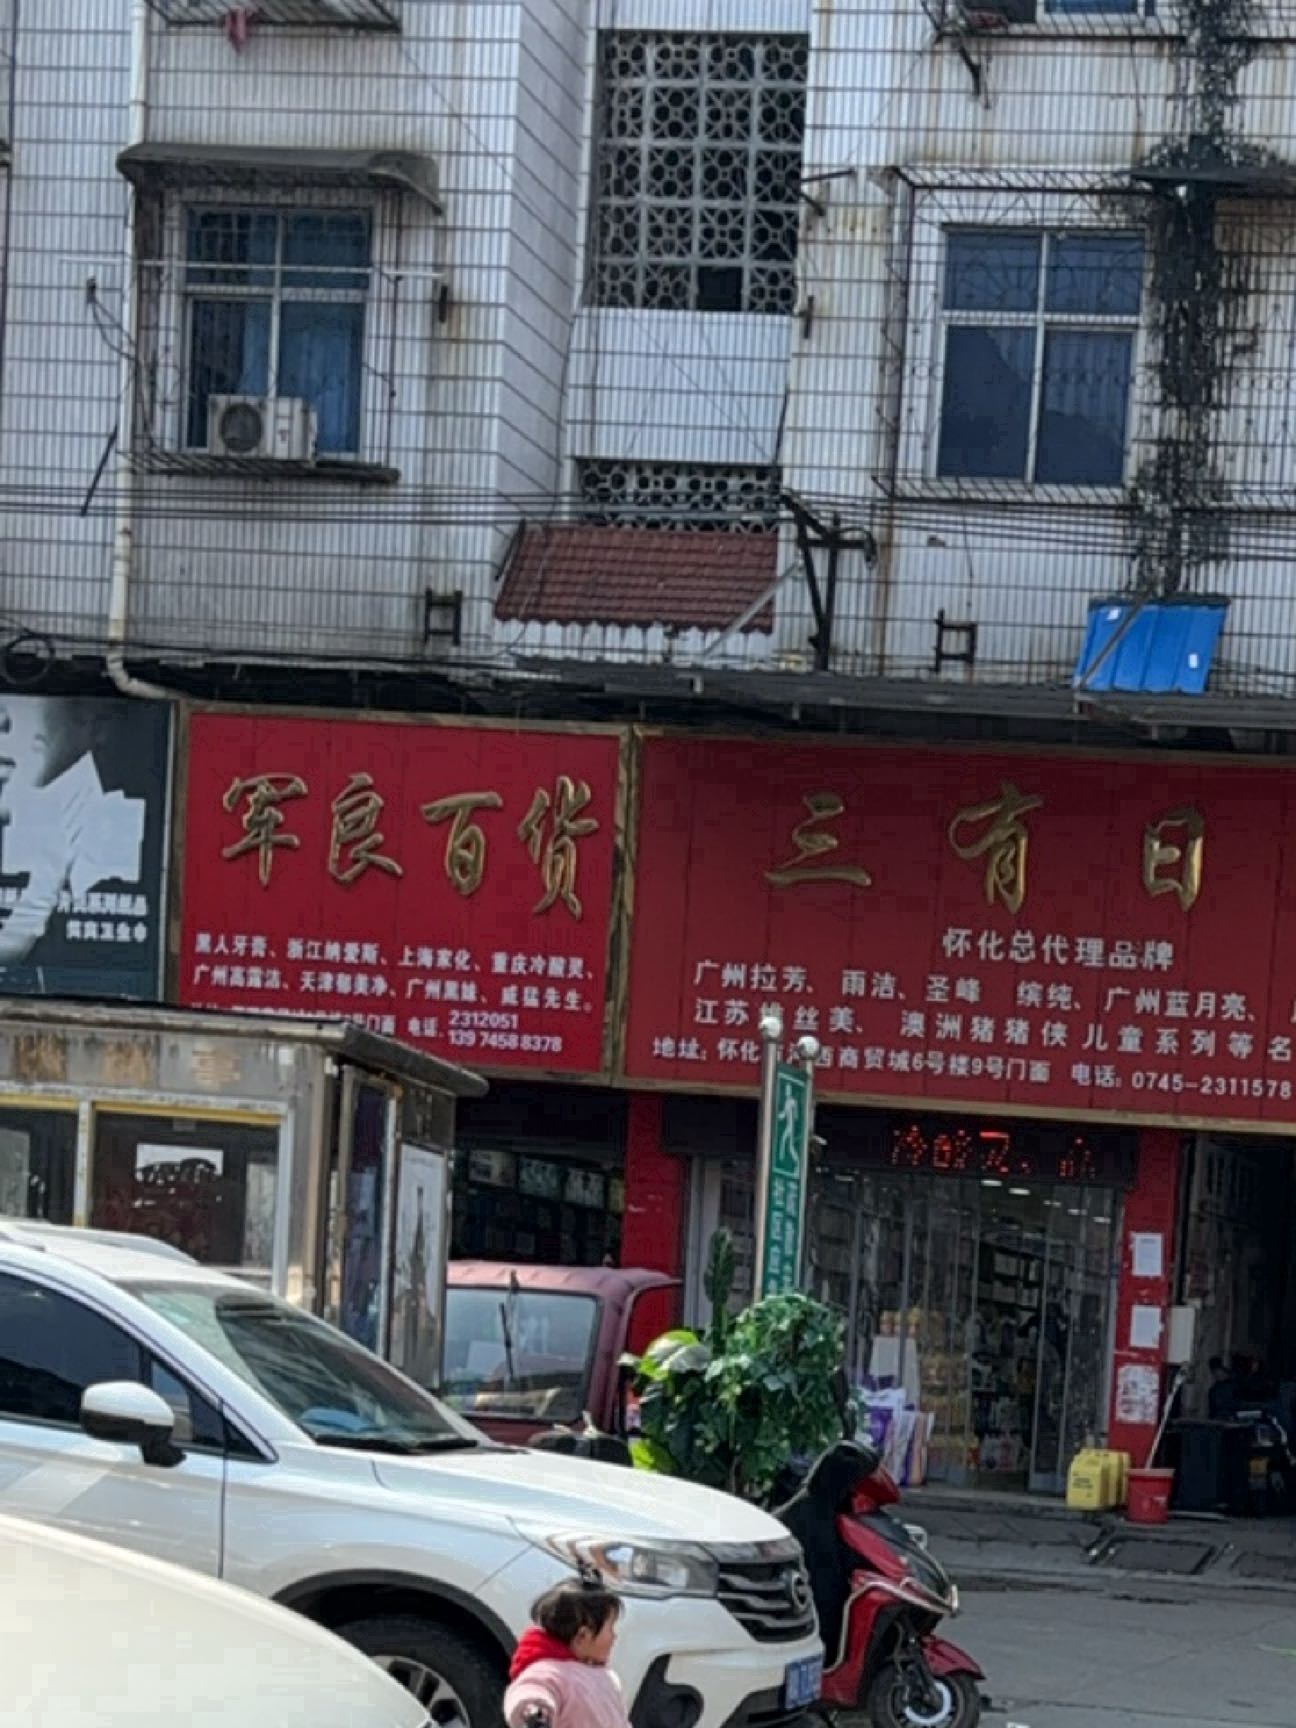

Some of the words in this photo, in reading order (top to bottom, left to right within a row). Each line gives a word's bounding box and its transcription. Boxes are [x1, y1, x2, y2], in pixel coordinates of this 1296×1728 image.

[221, 770, 600, 920] 军良百货
[943, 927, 1175, 972] 怀化总代理品牌
